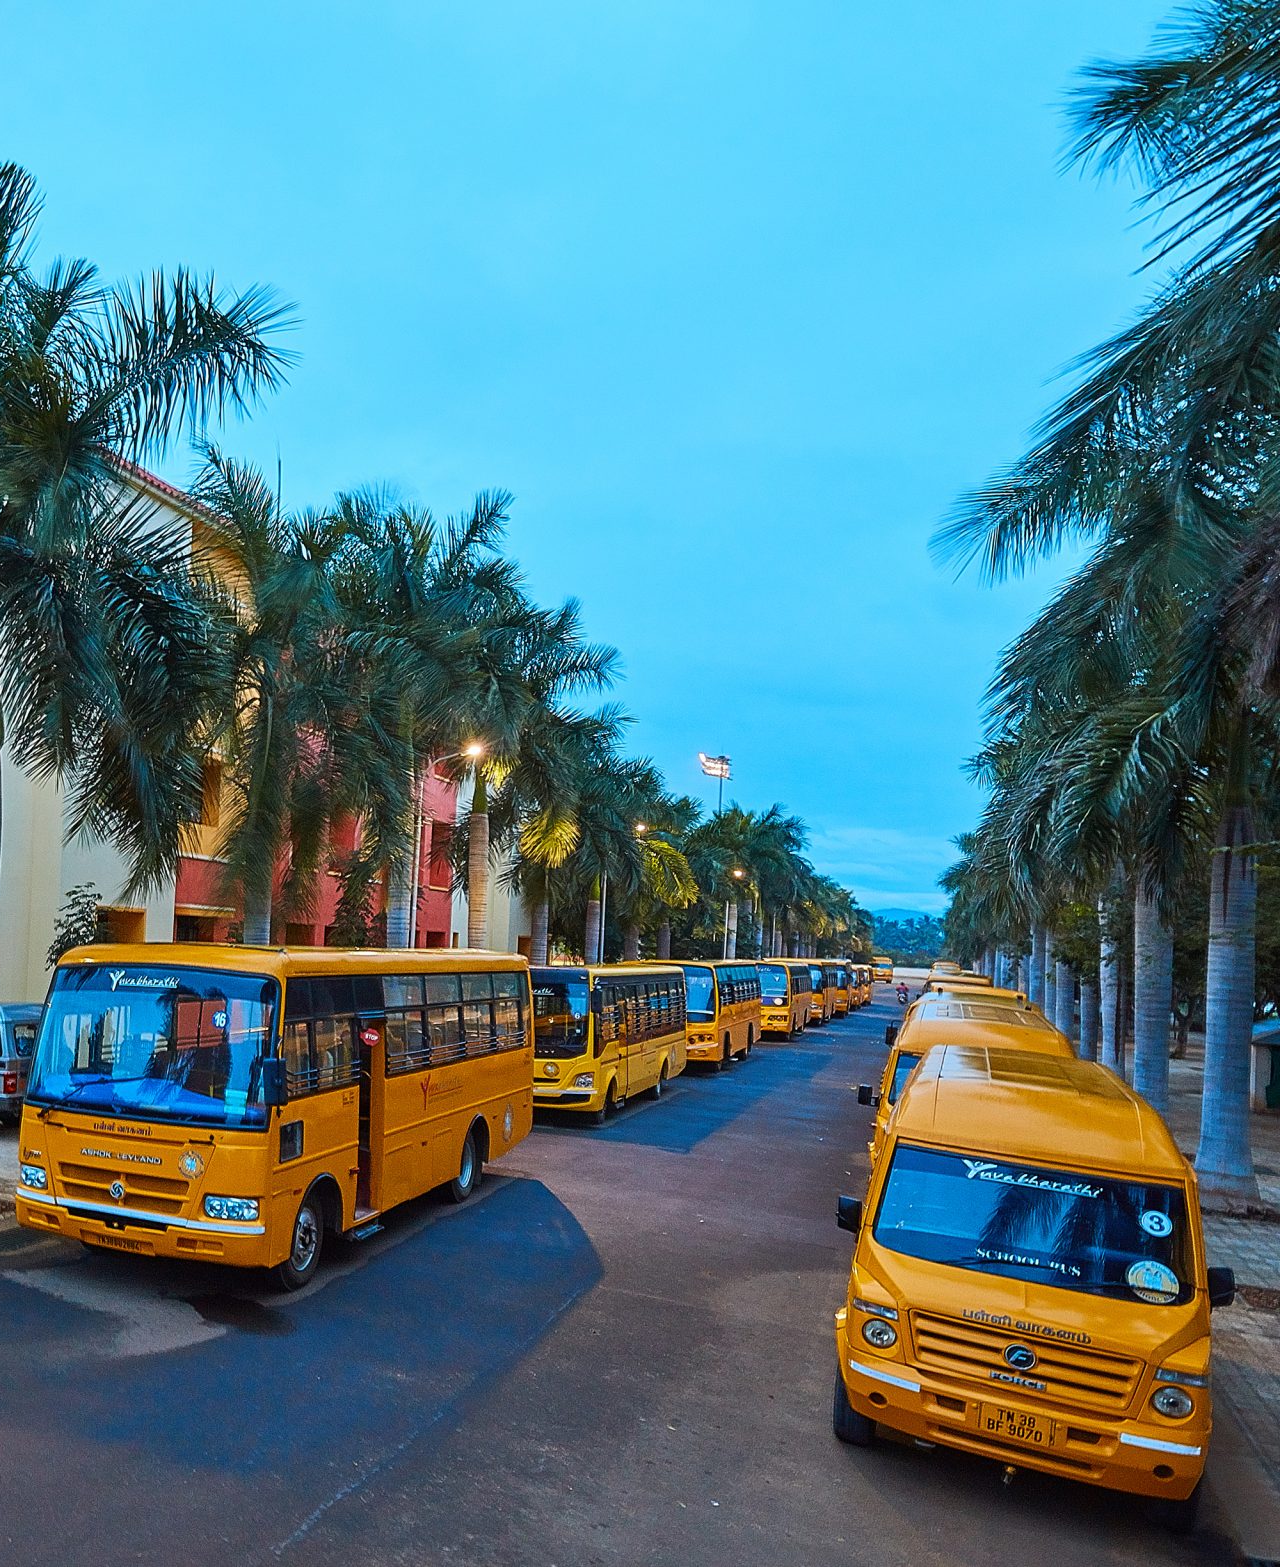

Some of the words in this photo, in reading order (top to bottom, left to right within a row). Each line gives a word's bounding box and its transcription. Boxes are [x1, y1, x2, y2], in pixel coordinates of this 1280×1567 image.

[109, 970, 180, 992] Yuvabharathi
[214, 1012, 226, 1027] 16
[365, 1033, 379, 1041] STOP
[81, 1147, 112, 1159] ASHOK
[116, 1152, 162, 1165] LEYLAND
[961, 1158, 1104, 1199] Yuvabharathi
[1149, 1214, 1166, 1232] 3
[989, 1370, 1047, 1391] FORCE
[996, 1408, 1015, 1423] TN
[1019, 1413, 1037, 1429] 38
[986, 1417, 1005, 1432] BF
[1007, 1423, 1044, 1443] 9070
